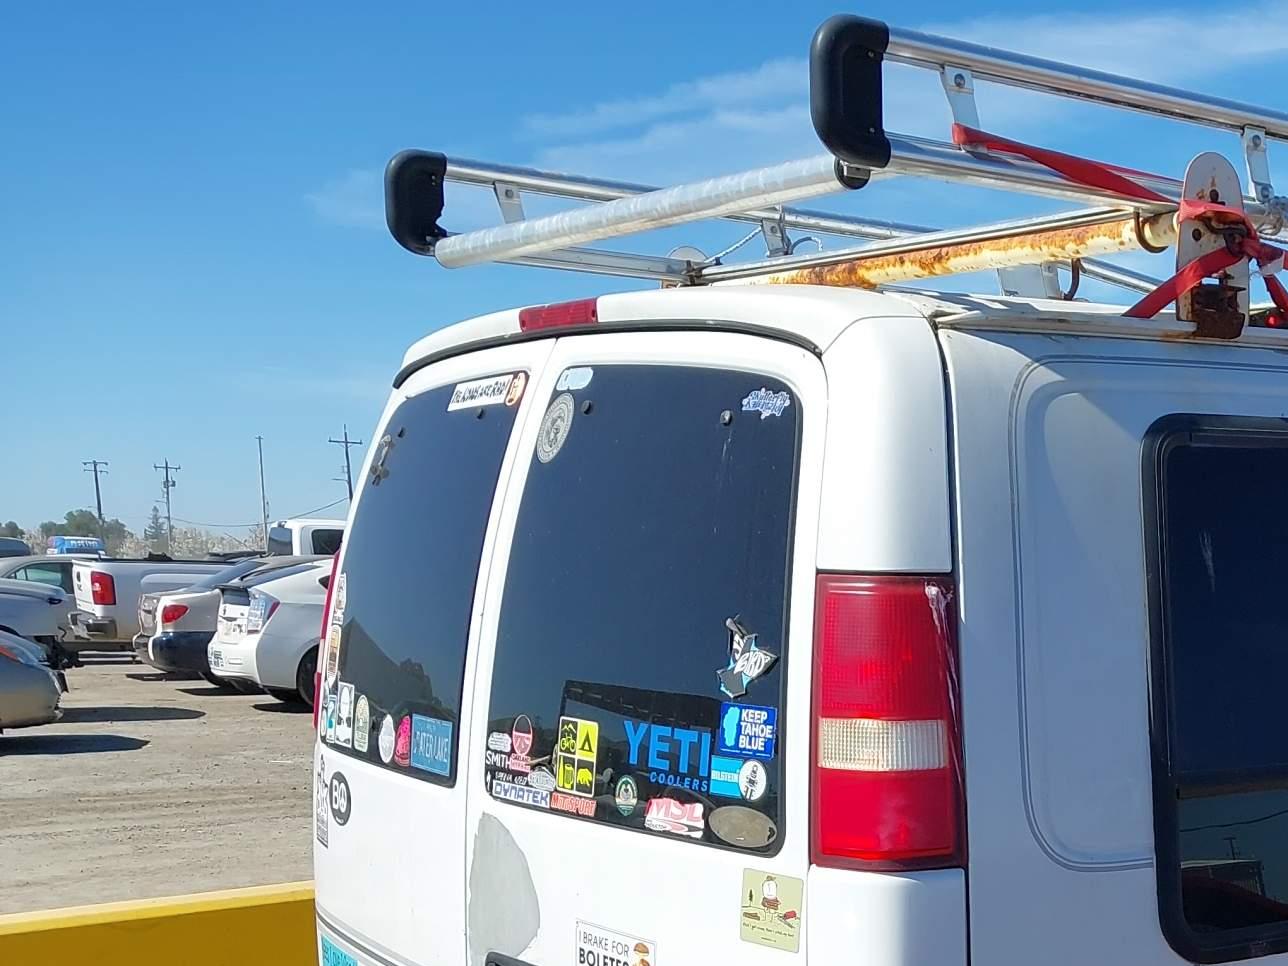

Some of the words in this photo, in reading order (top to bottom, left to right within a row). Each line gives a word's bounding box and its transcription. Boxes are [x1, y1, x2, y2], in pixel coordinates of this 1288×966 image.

[741, 708, 768, 723] KEEP
[740, 722, 773, 738] TAHOE
[434, 736, 449, 762] LAKE
[623, 720, 711, 776] YETI
[739, 735, 765, 750] BLUE
[485, 750, 511, 771] SMITH
[649, 771, 708, 792] COOLERS
[494, 782, 549, 806] DYNATEK
[579, 929, 582, 942] I
[583, 931, 609, 951] BRAKE
[612, 940, 630, 957] FOR
